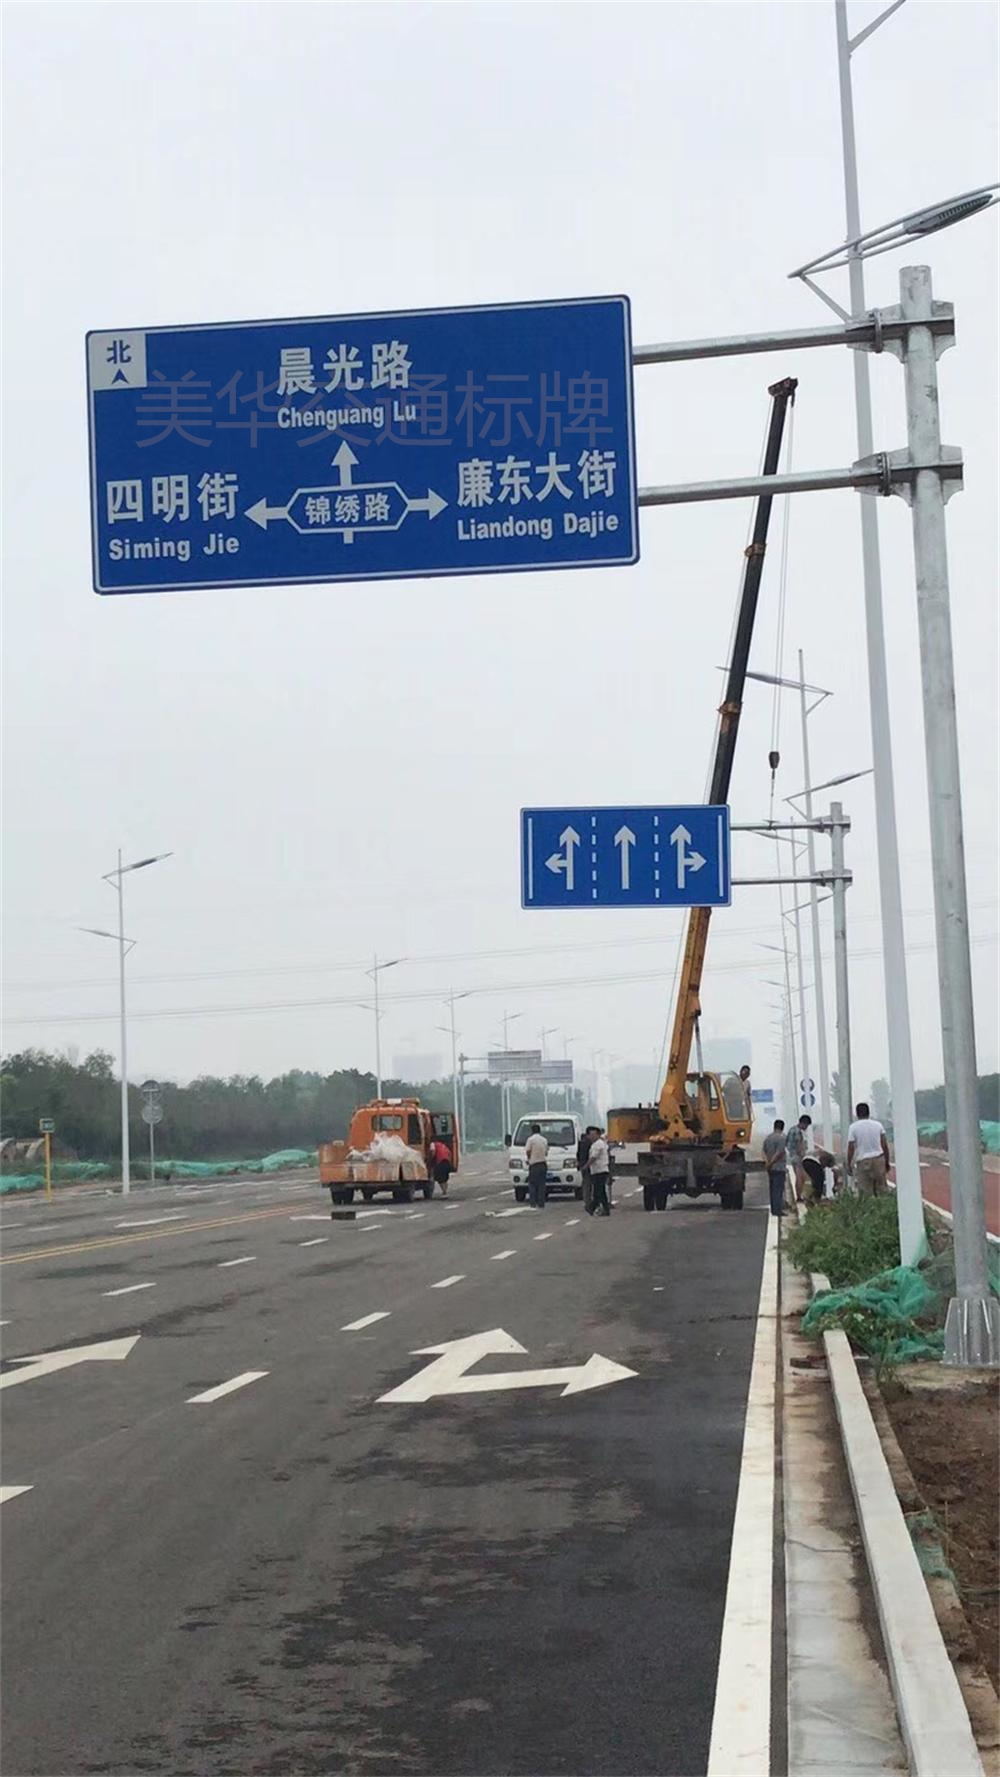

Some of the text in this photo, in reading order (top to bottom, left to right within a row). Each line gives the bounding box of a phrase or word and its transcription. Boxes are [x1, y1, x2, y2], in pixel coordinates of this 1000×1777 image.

[106, 341, 132, 365] 北
[277, 340, 413, 395] 晨光路
[277, 401, 416, 431] Chenguang Lu
[457, 449, 617, 508] 廉东大街
[106, 472, 238, 524] 四明街
[306, 494, 391, 525] 锦绣路
[457, 510, 619, 541] Liandong Dajie
[109, 533, 240, 562] Siming Jie
